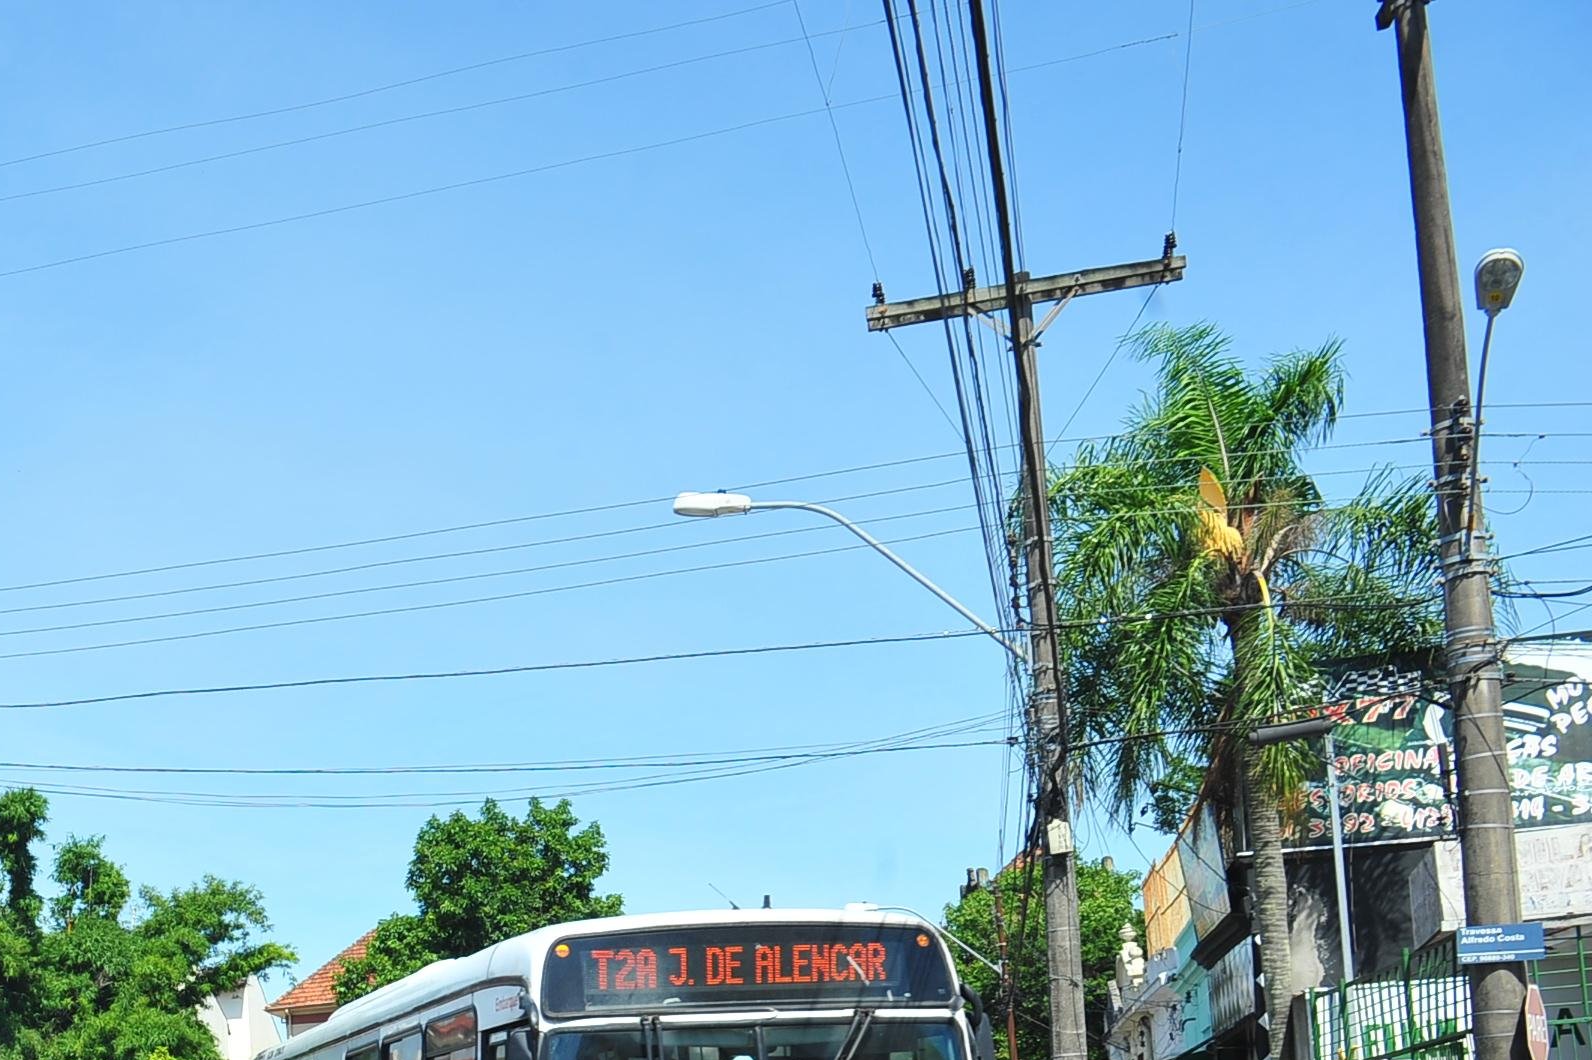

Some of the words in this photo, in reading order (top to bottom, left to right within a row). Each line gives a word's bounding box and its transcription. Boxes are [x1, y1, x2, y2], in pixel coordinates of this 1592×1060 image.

[1459, 927, 1503, 936] Travessa
[1461, 936, 1496, 944] Alfredo
[1497, 933, 1525, 942] Costa
[591, 949, 657, 991] T2A
[668, 948, 695, 986] J.
[705, 945, 744, 986] DE
[754, 942, 887, 984] ALENCAR
